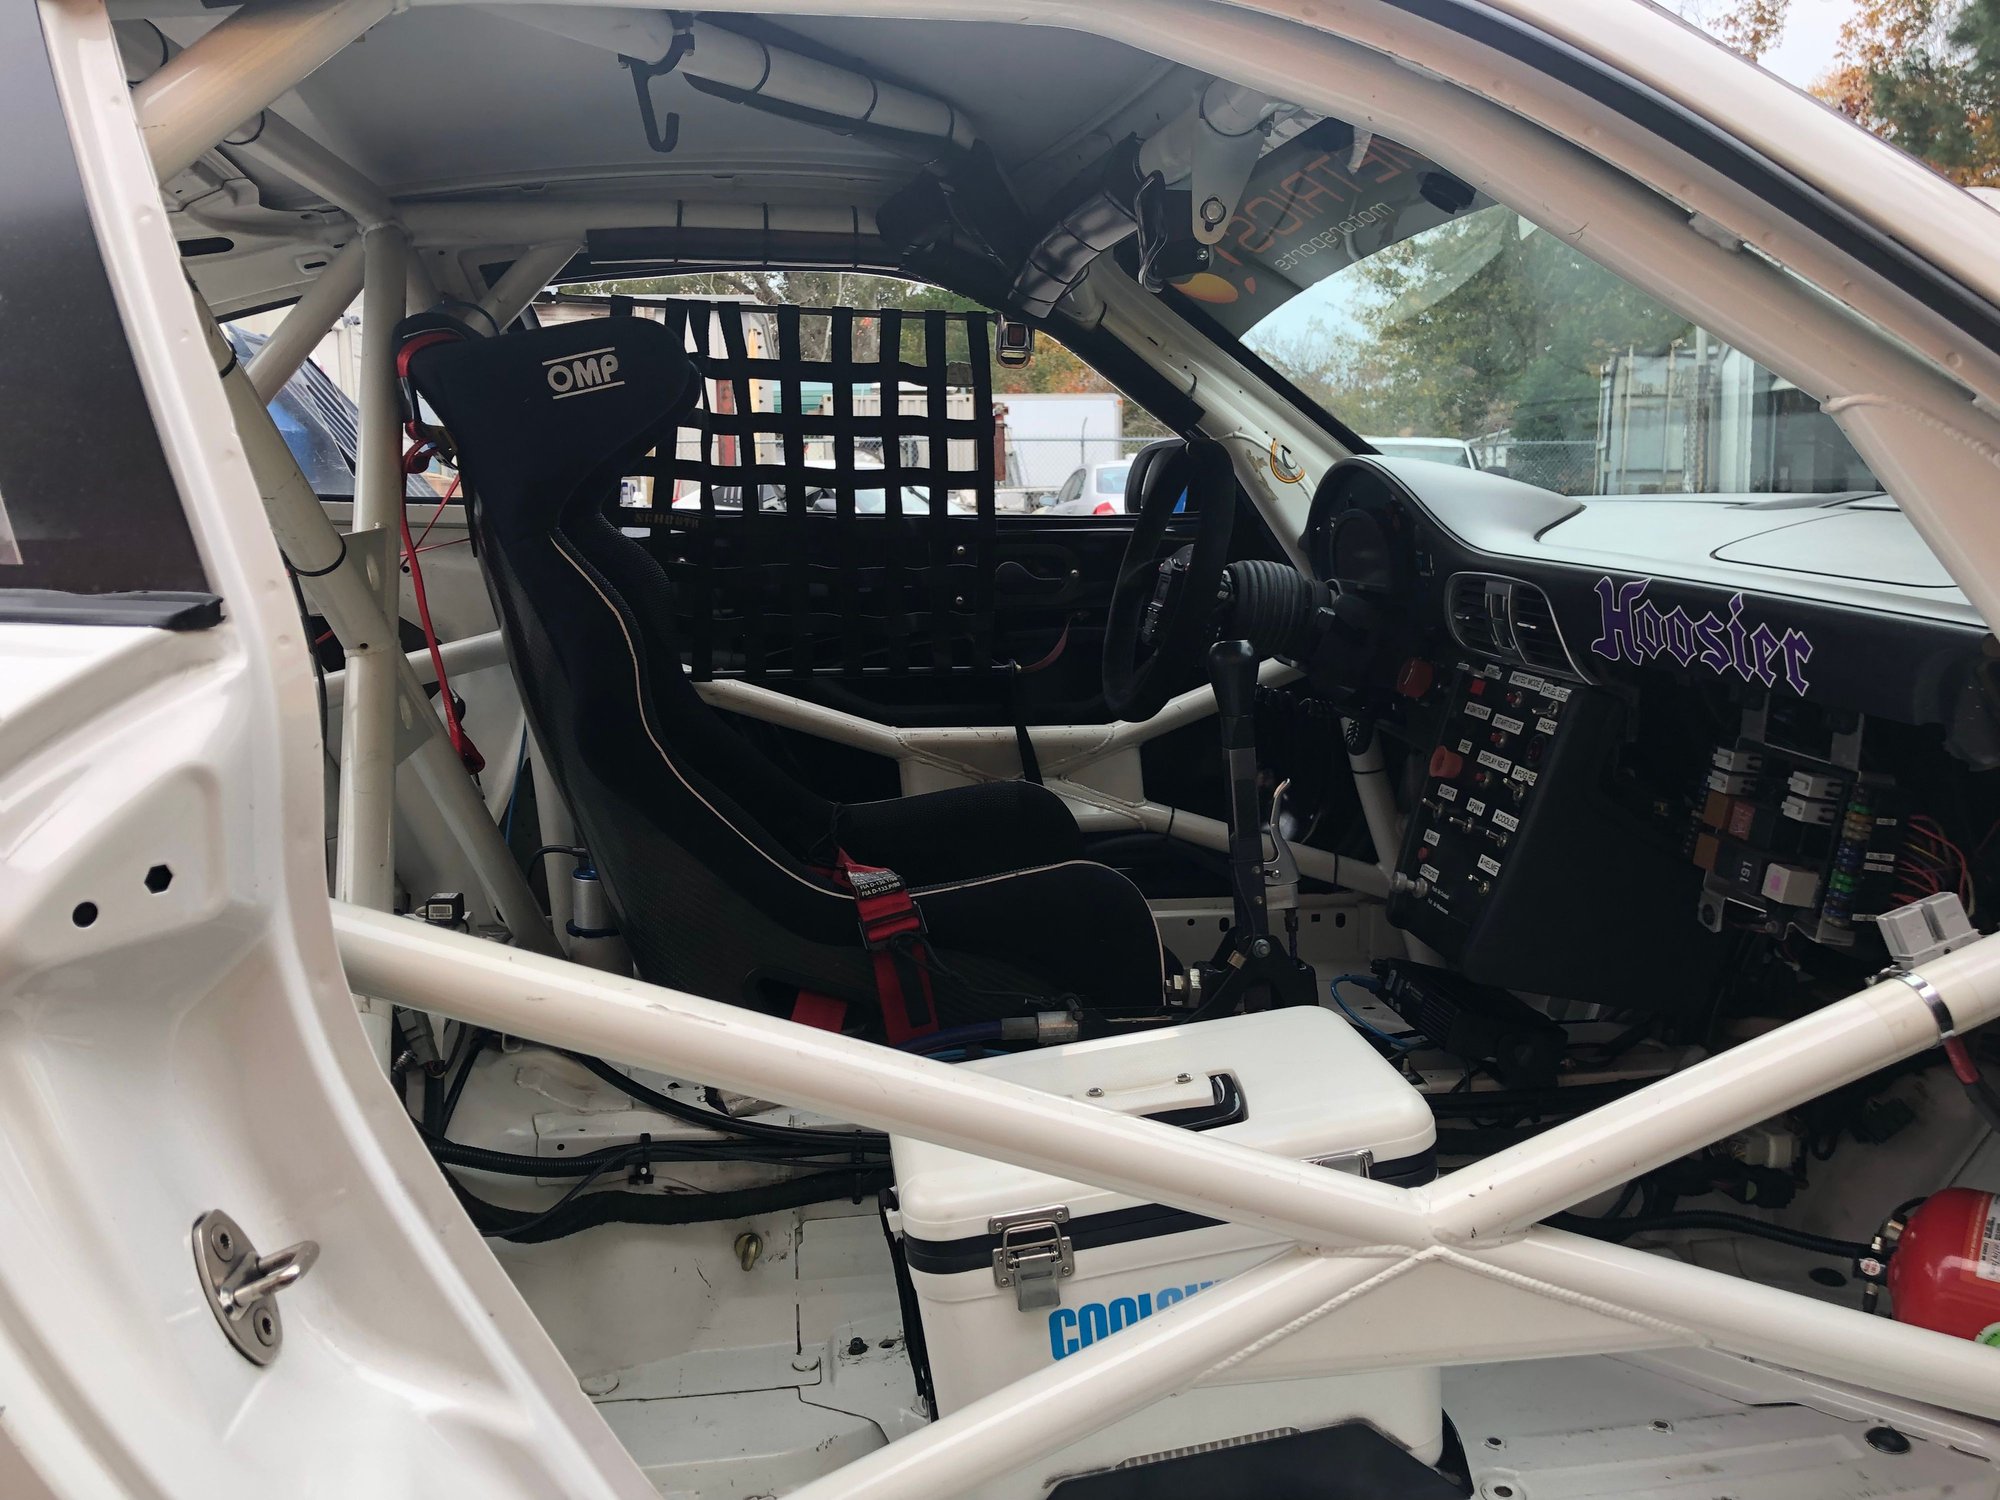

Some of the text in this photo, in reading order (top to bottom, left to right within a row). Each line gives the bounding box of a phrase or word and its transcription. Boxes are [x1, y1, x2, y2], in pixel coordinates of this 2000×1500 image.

[546, 353, 620, 393] OMP
[1591, 575, 1814, 697] Hoosier
[1496, 759, 1510, 770] NEXT
